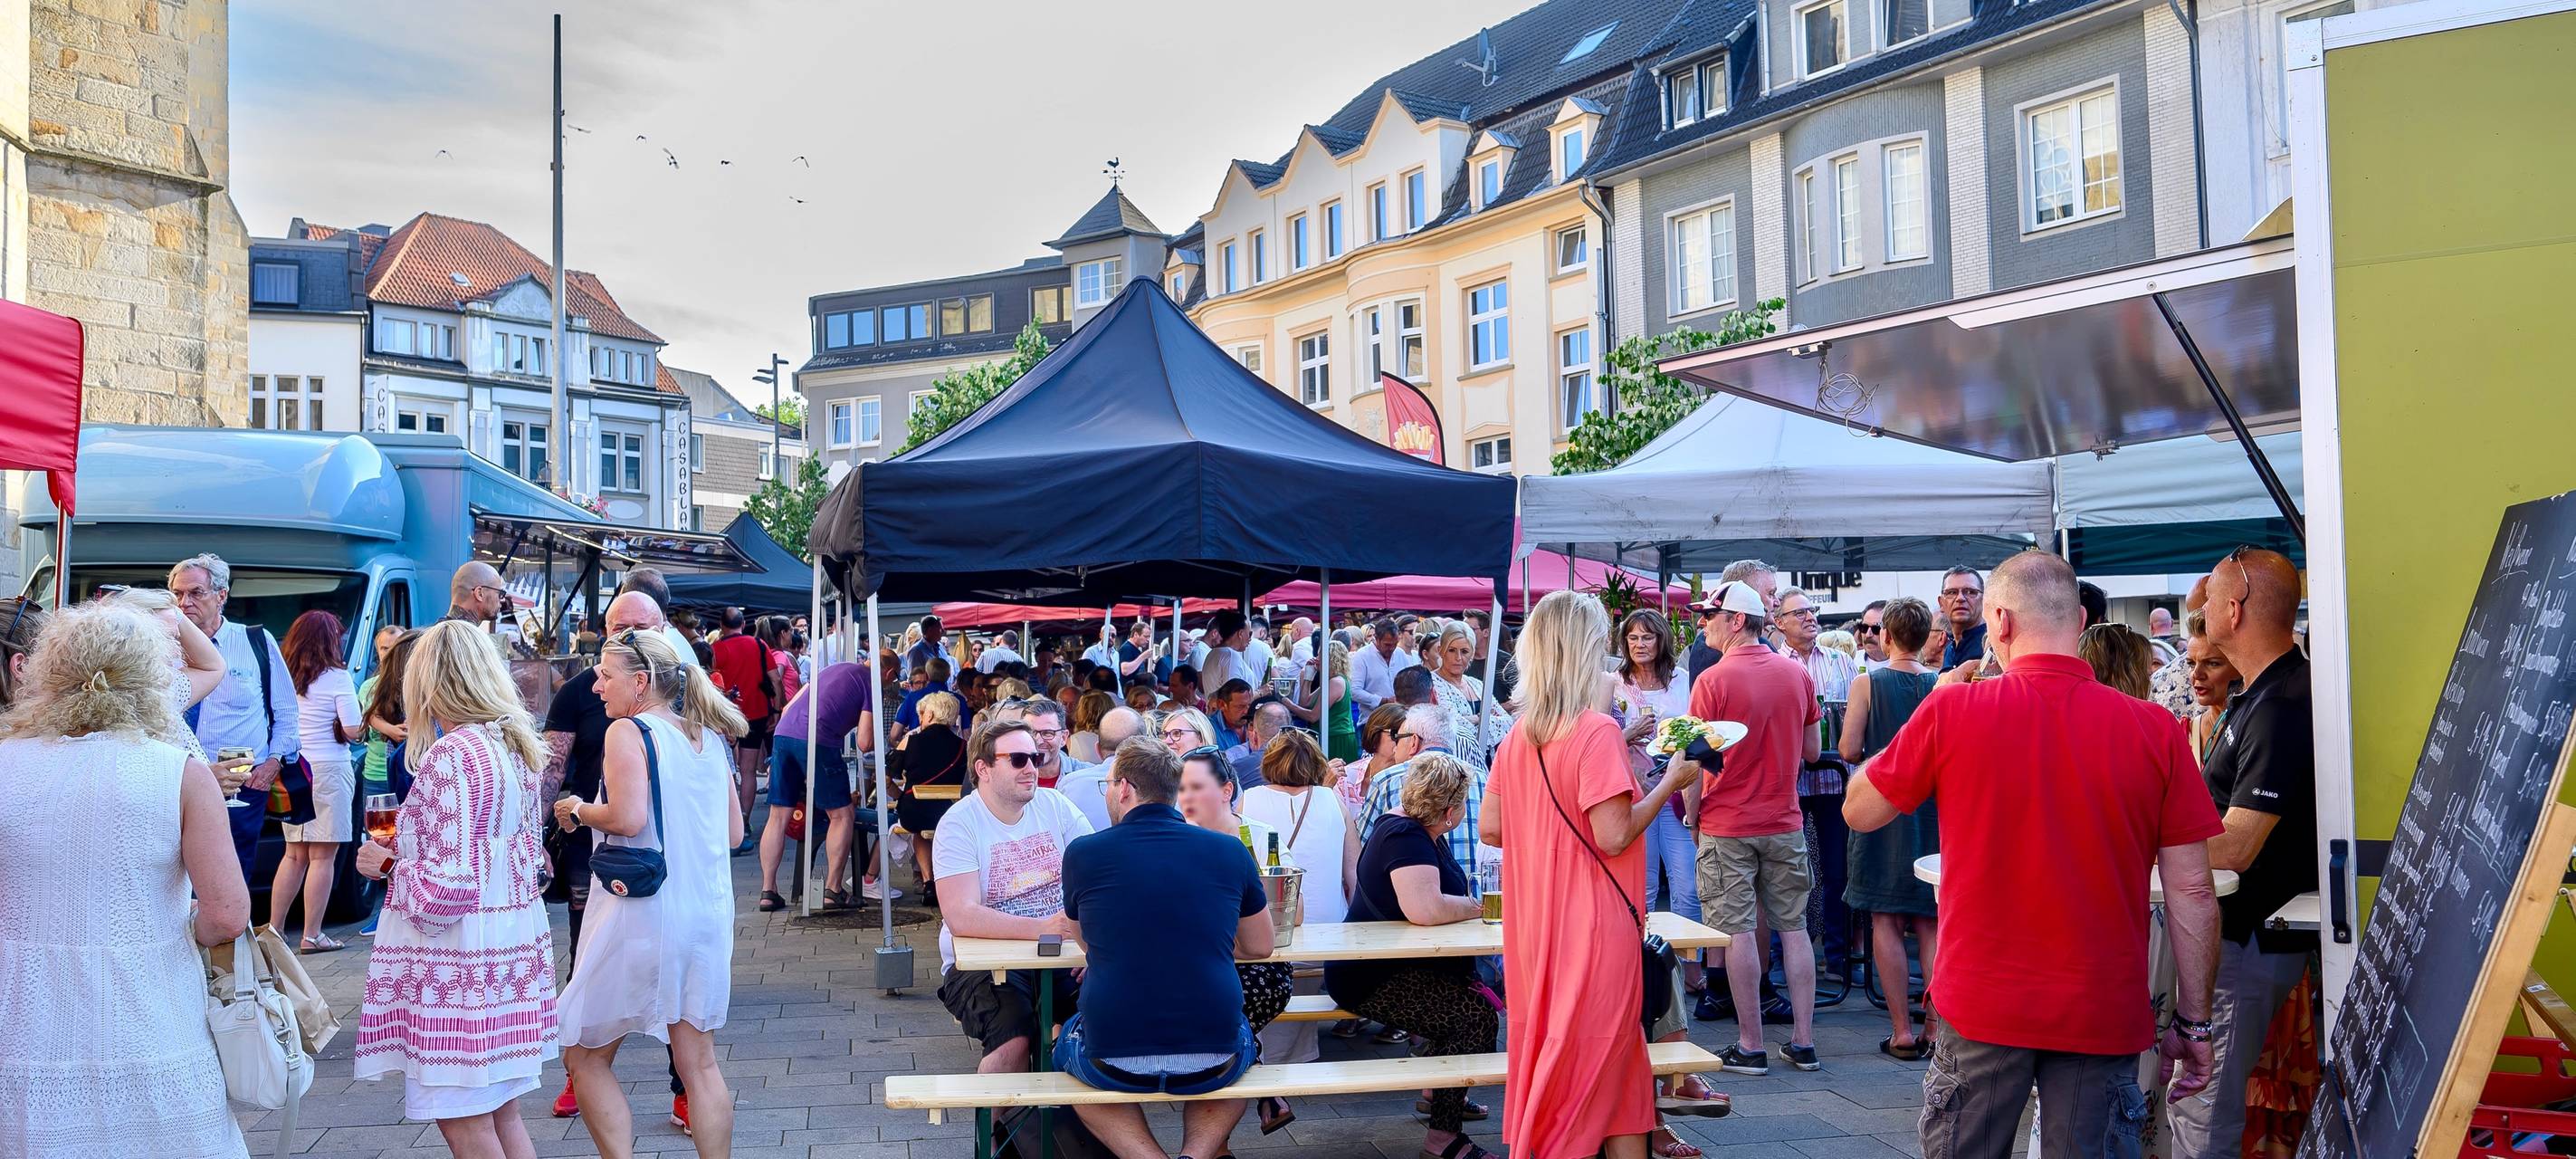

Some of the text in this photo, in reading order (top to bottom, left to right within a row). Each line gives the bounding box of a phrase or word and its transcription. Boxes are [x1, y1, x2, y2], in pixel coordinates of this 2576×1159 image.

[678, 421, 688, 531] CASABLA
[2260, 790, 2278, 799] JAKO
[1032, 844, 1057, 857] AFRICA
